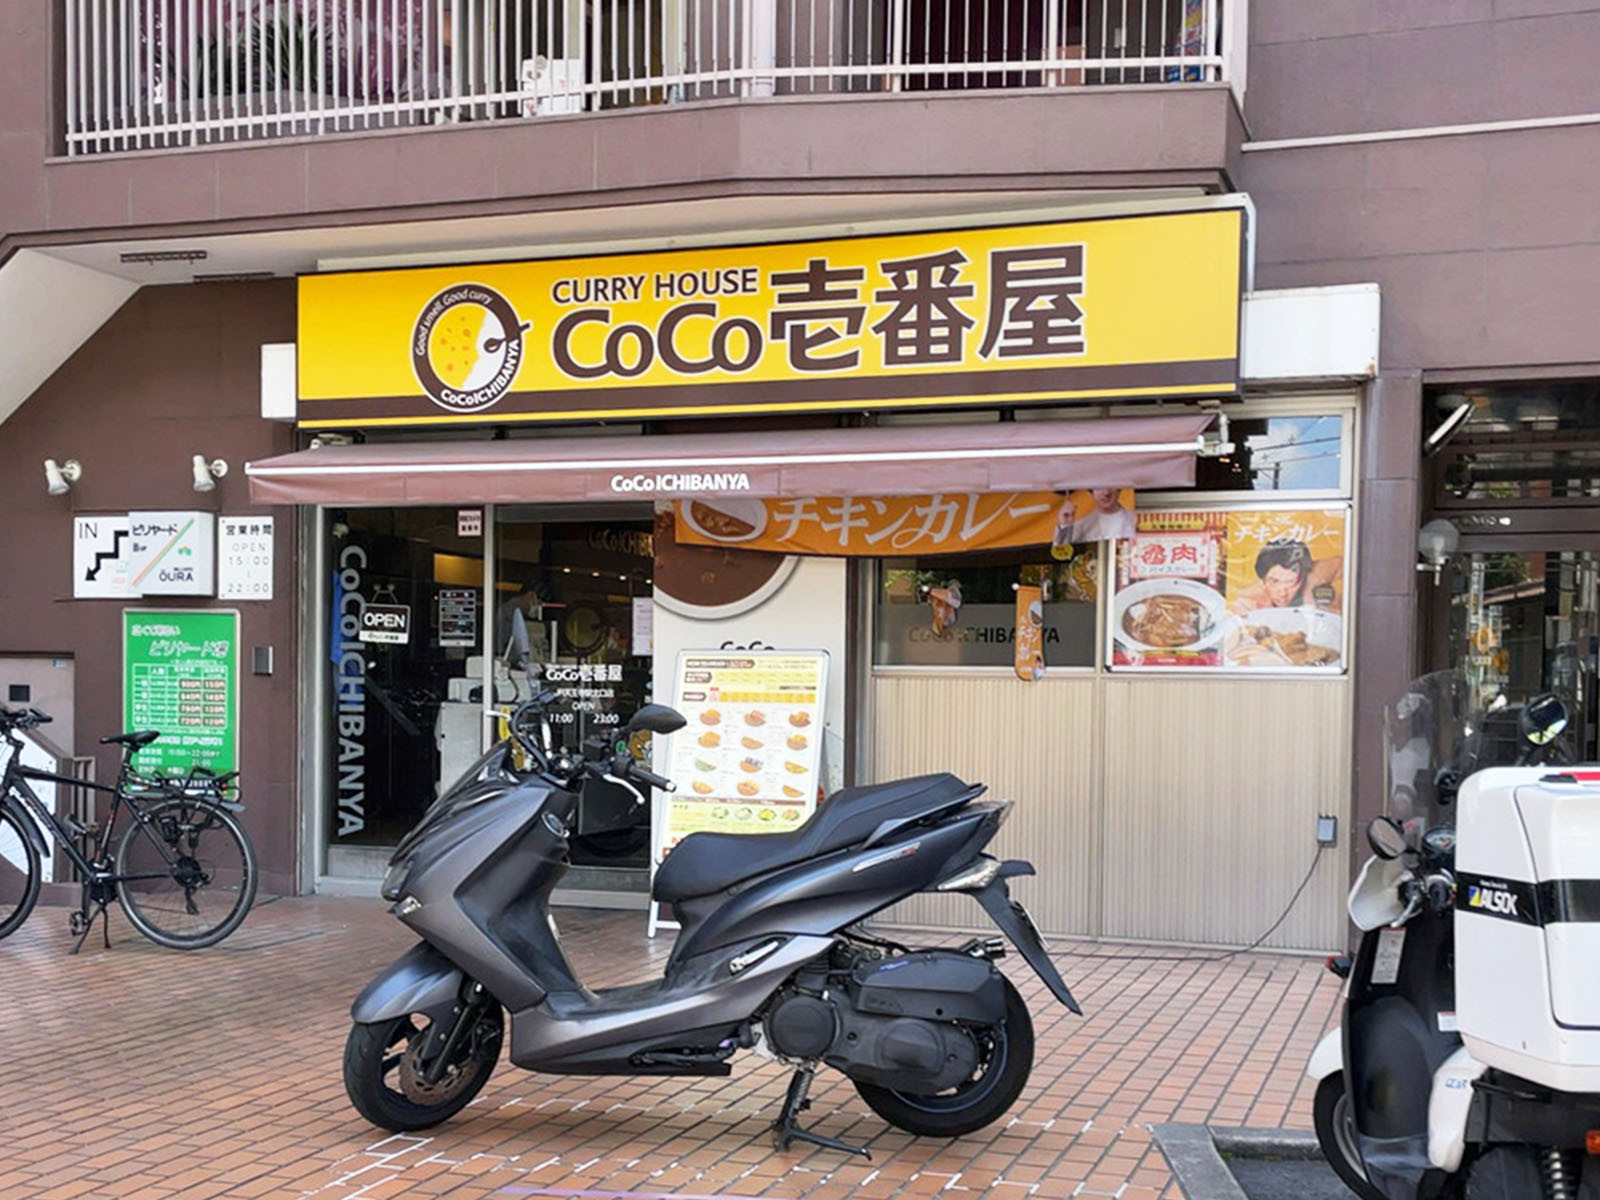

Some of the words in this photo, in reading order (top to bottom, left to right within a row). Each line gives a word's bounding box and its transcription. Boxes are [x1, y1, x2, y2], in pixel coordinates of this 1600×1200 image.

[553, 275, 645, 305] CURRY
[654, 267, 758, 297] HOUSE
[552, 245, 1087, 380] CoCo壱番屋
[440, 338, 520, 406] CoCoICHIBANYA
[773, 493, 1050, 549] チキンカレー
[79, 522, 97, 539] IN
[132, 523, 178, 537] ビリヤード
[226, 524, 273, 537] 営業時間
[1234, 523, 1339, 546] チキンカレー
[232, 543, 267, 553] OPEN
[228, 556, 269, 566] 15:00
[228, 583, 270, 593] 22:00
[364, 611, 406, 628] OPEN
[546, 664, 623, 681] CoCo壱番屋
[572, 701, 595, 711] OPEN
[549, 713, 574, 724] 11:00
[593, 713, 620, 724] 23:00
[1480, 888, 1519, 916] ALSOK
